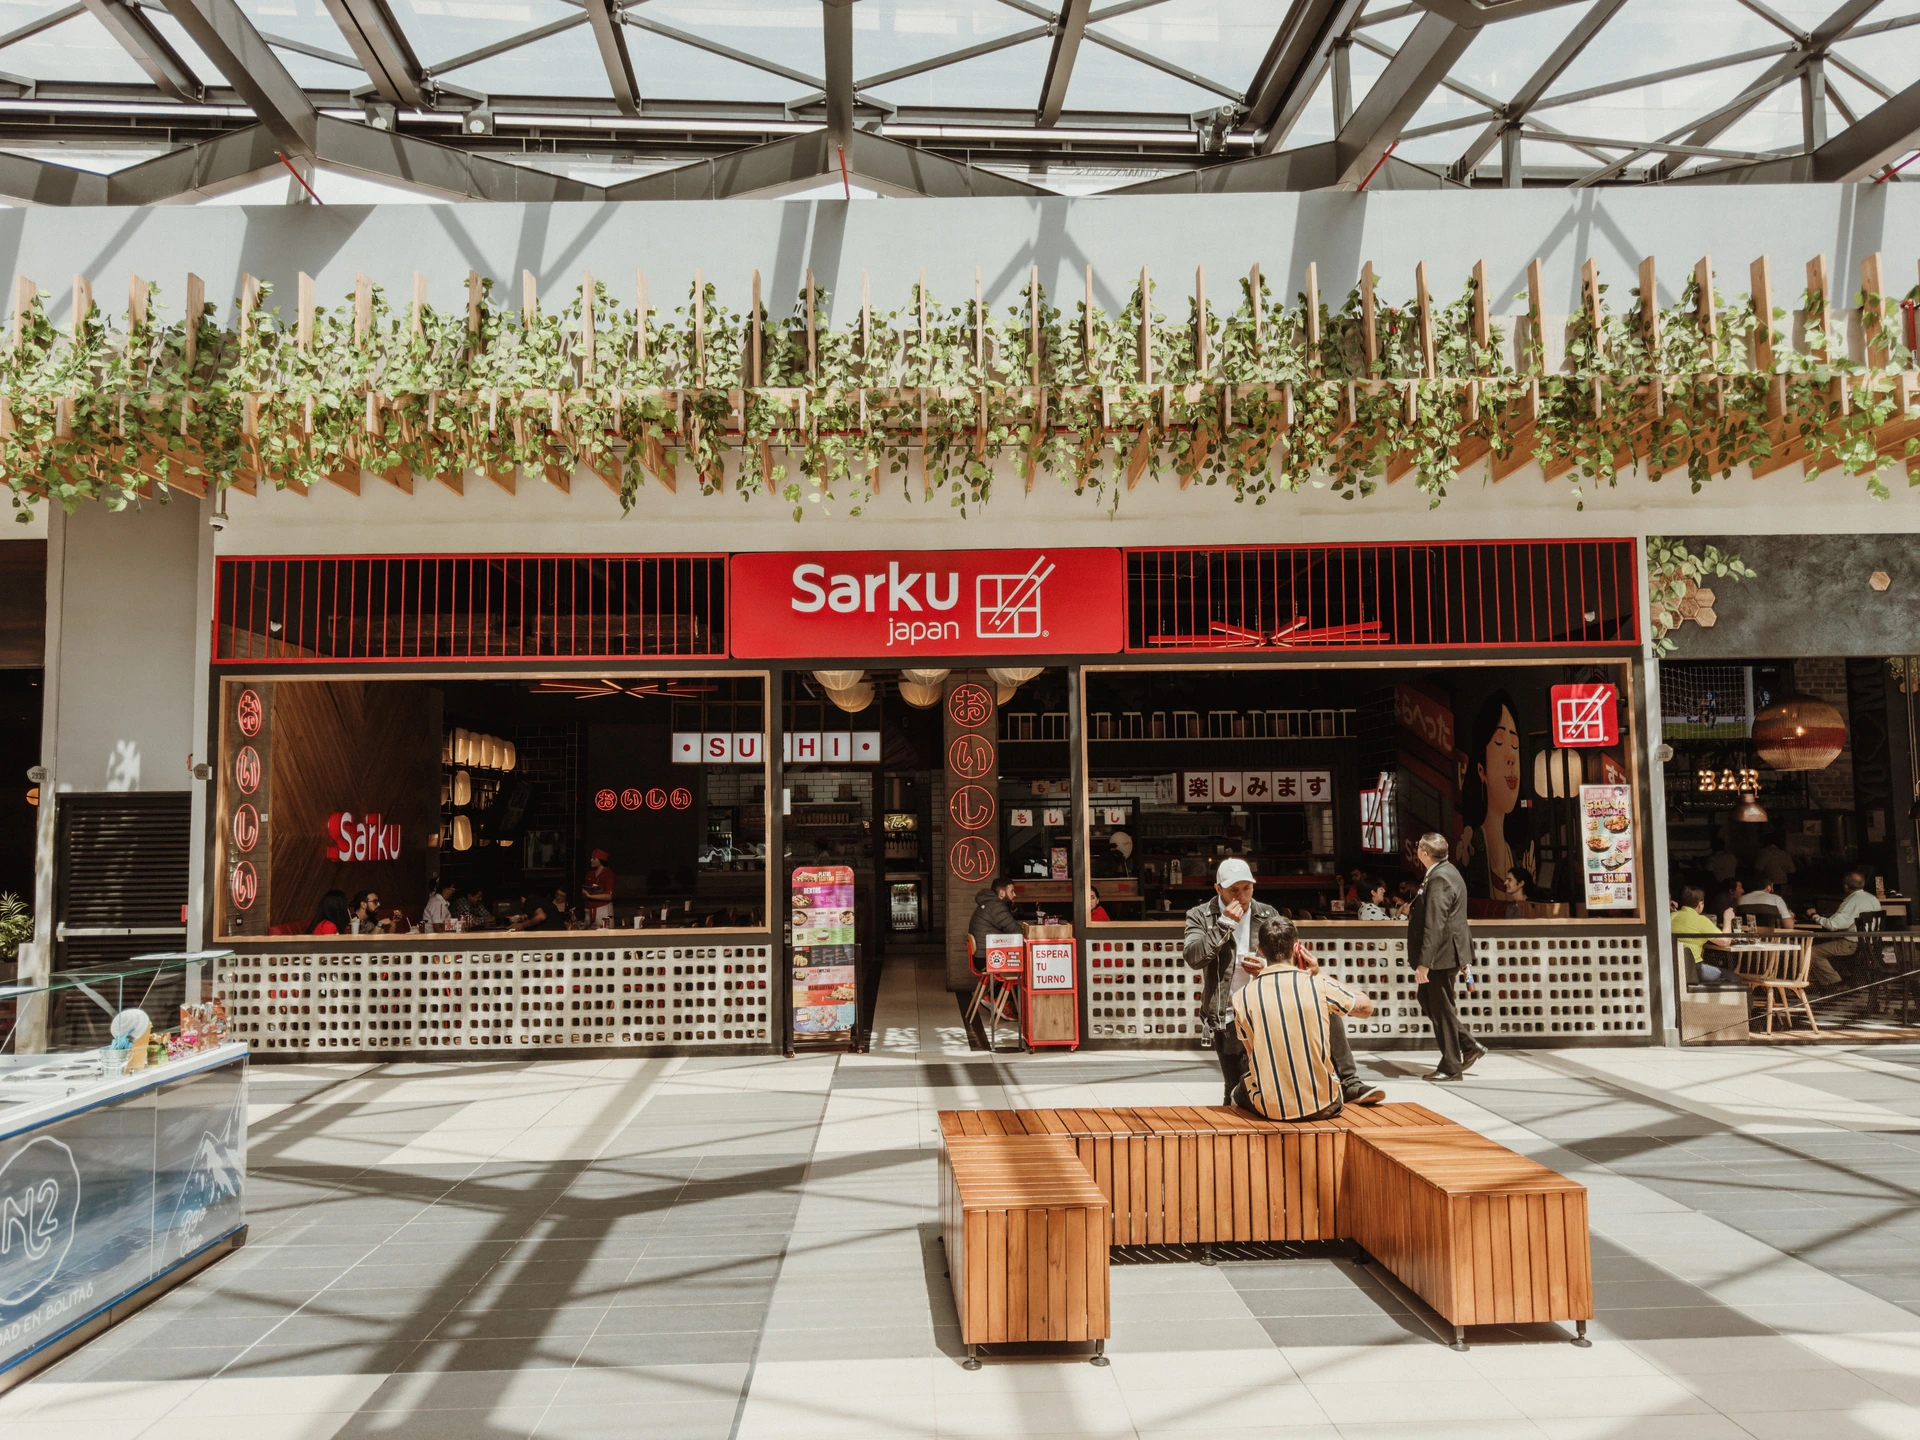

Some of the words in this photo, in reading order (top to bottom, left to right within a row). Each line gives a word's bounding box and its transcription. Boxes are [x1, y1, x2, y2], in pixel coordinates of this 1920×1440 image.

[791, 561, 960, 614] Sarku
[886, 617, 960, 646] japan
[709, 737, 840, 757] SUHI
[1188, 776, 1327, 798] 楽しみます
[1697, 768, 1762, 792] BAR
[330, 811, 402, 861] Sarku
[1035, 949, 1070, 959] ESPERA
[1036, 962, 1047, 971] TU
[1036, 974, 1066, 984] TURNO
[23, 1311, 41, 1334] EN
[45, 1281, 95, 1323] BOLITAS
